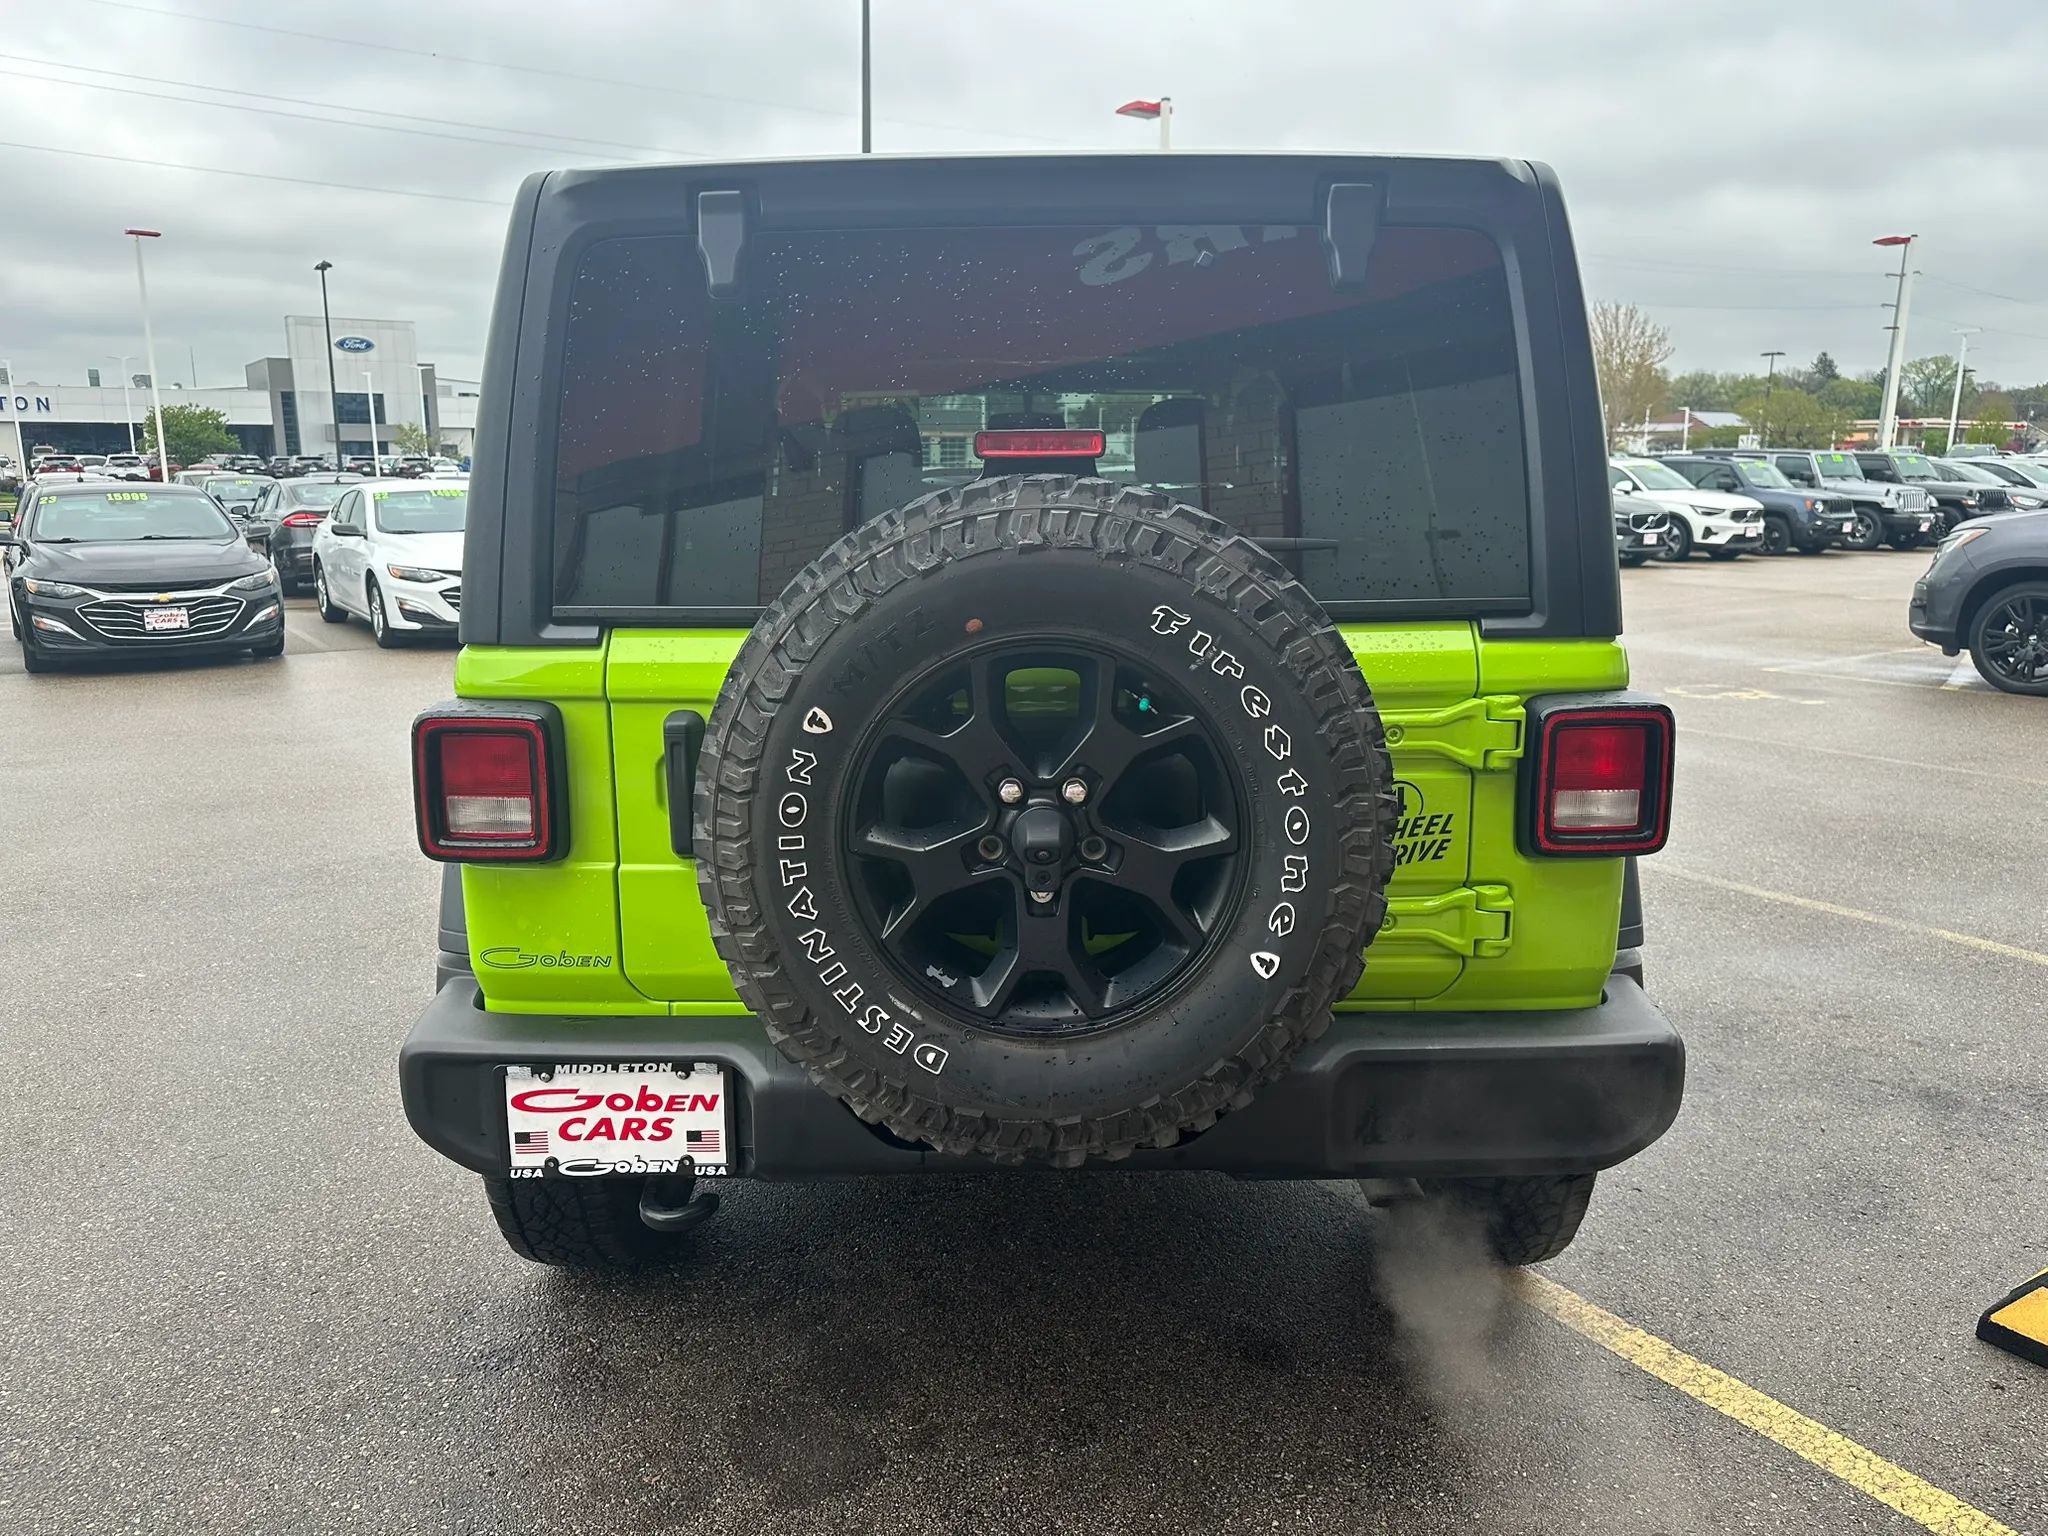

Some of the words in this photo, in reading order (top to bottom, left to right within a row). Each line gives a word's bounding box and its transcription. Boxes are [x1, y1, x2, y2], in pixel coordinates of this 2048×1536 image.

[343, 339, 367, 349] Ford
[39, 495, 57, 505] 23
[1150, 605, 1310, 938] Firestone
[1392, 813, 1454, 840] HEEL
[1396, 838, 1452, 866] RIVE
[778, 749, 950, 1075] DESTINATION
[554, 1062, 673, 1074] MIDDLETON
[558, 1117, 675, 1142] CARS
[510, 1168, 544, 1179] USA
[694, 1165, 728, 1176] USA
